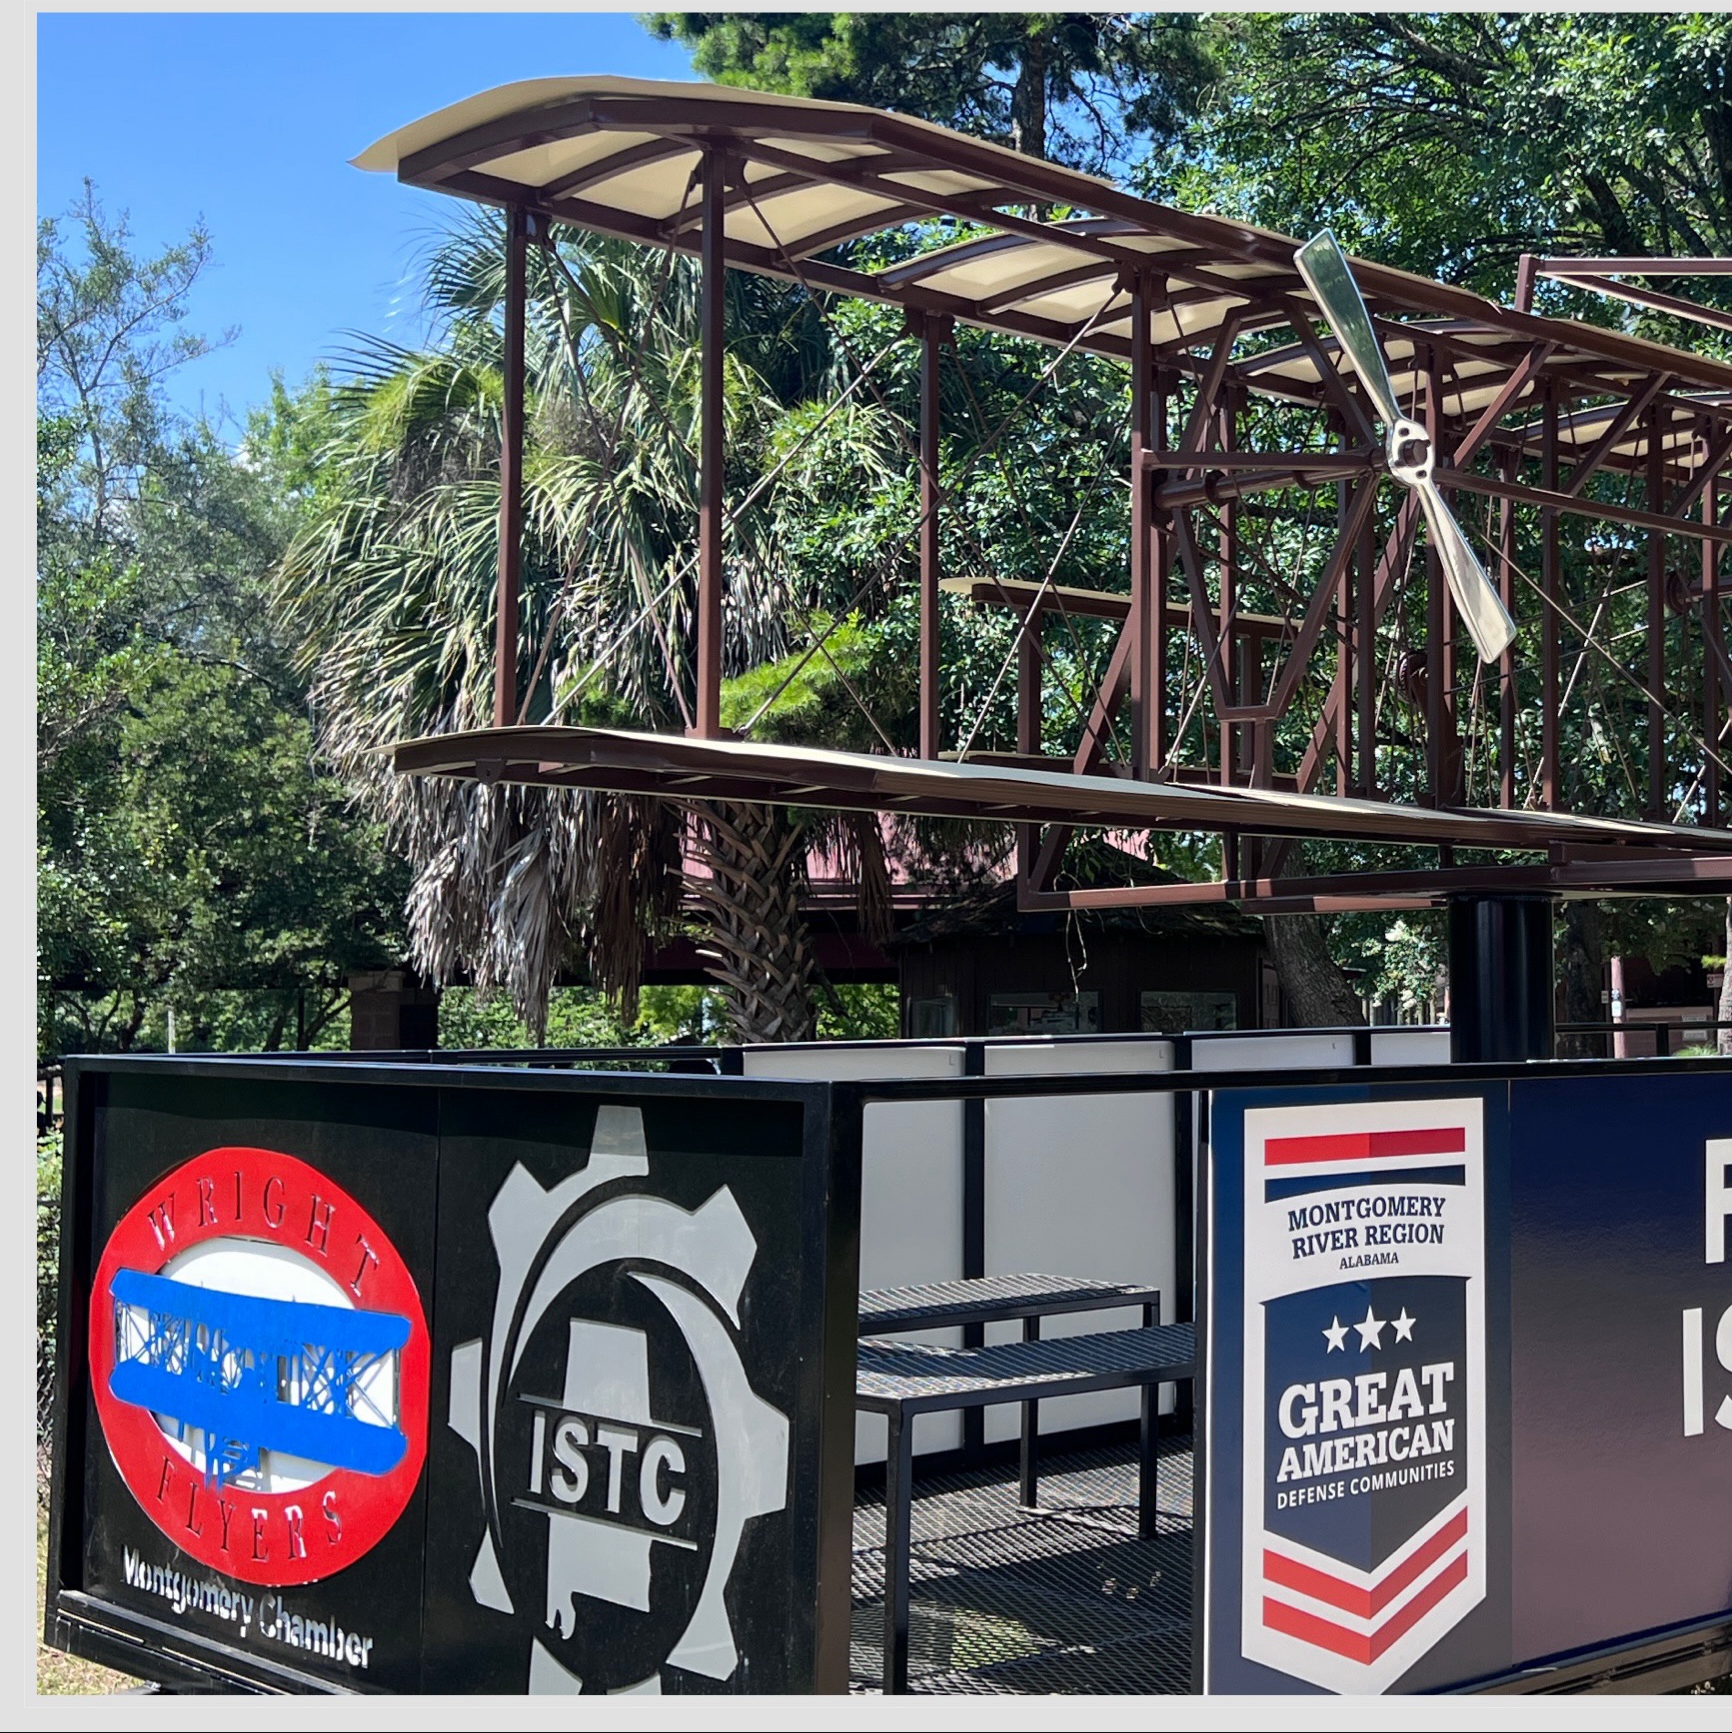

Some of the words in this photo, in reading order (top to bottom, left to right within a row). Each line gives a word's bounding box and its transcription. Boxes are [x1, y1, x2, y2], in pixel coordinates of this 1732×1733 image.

[148, 1170, 380, 1297] WRIGHT
[1288, 1196, 1446, 1232] MONTGOMERY
[1291, 1227, 1359, 1259] RIVER
[1365, 1223, 1445, 1245] REGION
[1339, 1252, 1399, 1269] ALABAMA
[1278, 1361, 1454, 1439] GREAT
[529, 1410, 686, 1526] ISTC
[1276, 1419, 1455, 1483] AMERICAN
[1277, 1481, 1345, 1510] DEFENSE
[1350, 1460, 1455, 1495] COMMUNITIES
[156, 1456, 343, 1562] FLYERS
[122, 1544, 254, 1637] Montgomery
[259, 1592, 374, 1669] Chamber
